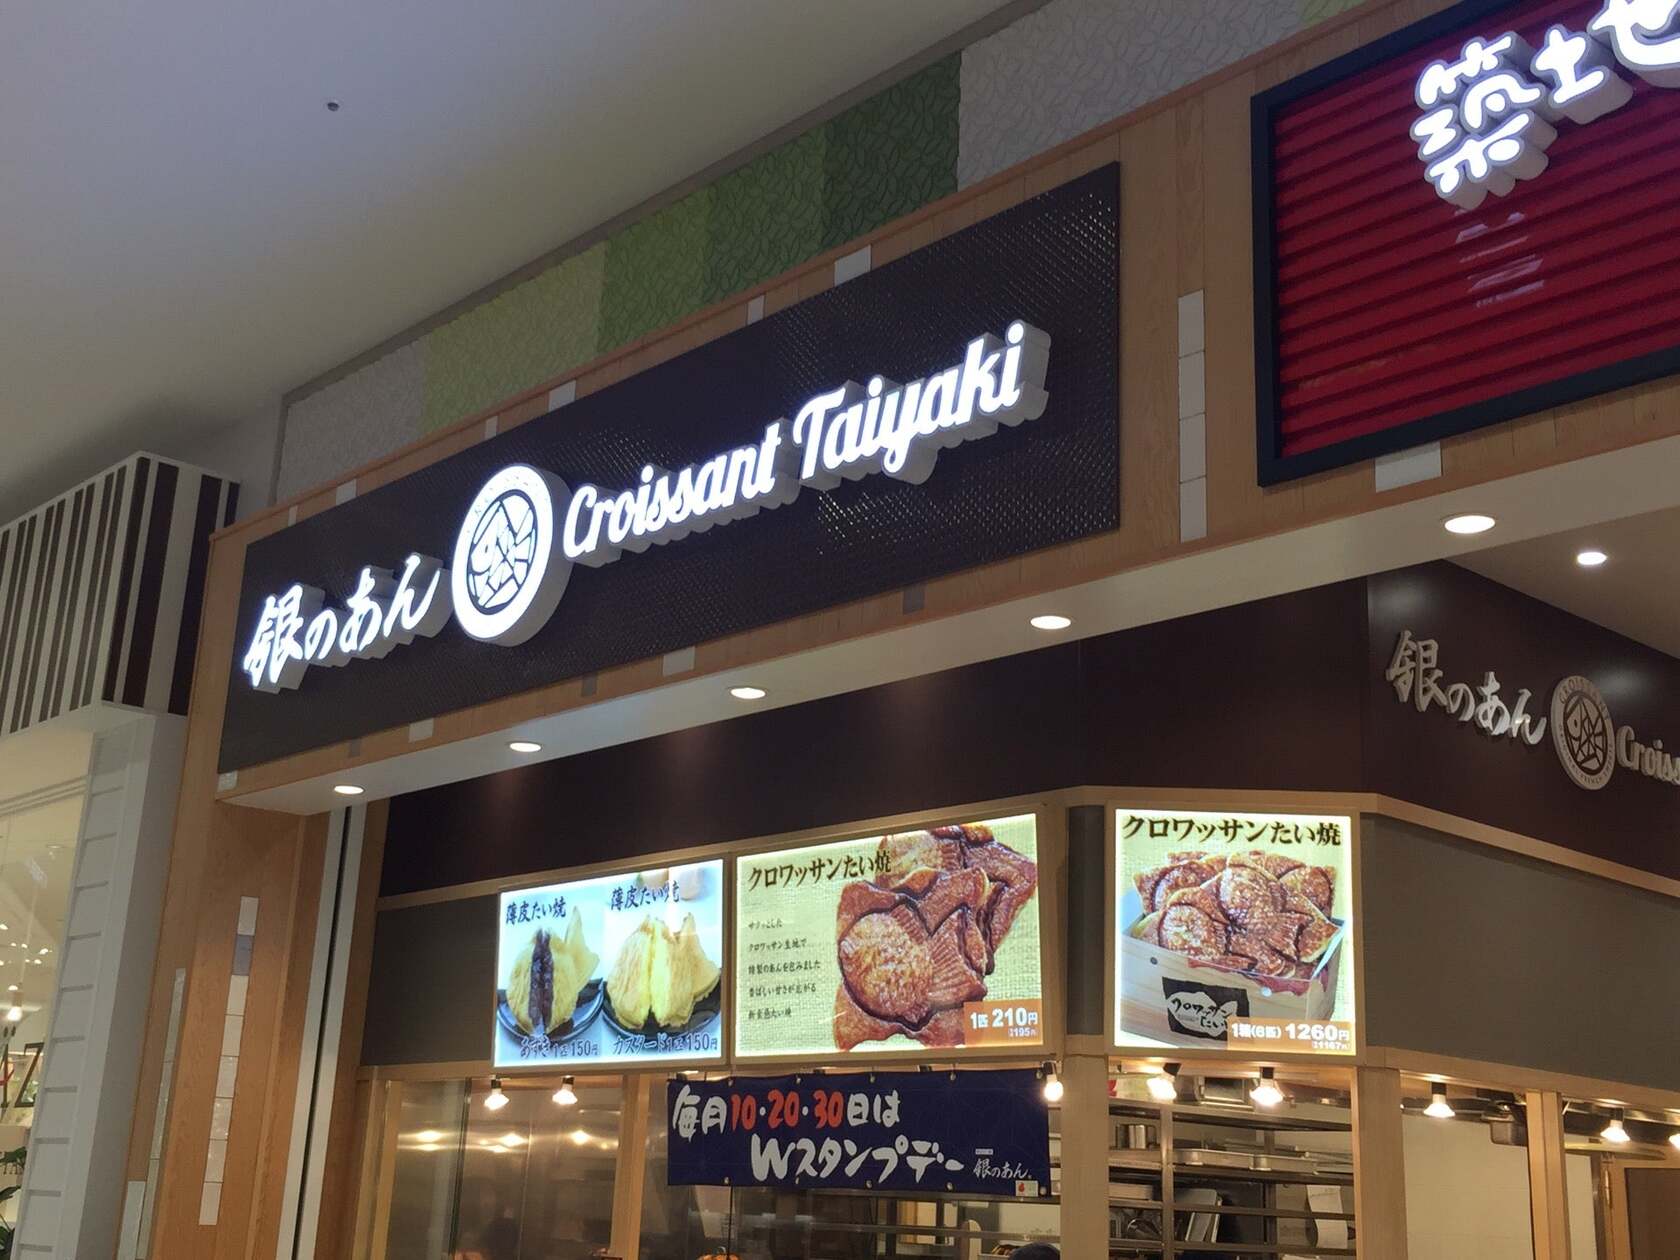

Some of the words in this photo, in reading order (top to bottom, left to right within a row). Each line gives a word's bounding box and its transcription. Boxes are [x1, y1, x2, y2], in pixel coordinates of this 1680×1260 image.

[563, 425, 781, 558] Croissant
[793, 321, 1023, 479] Taiyaki
[243, 552, 440, 687] 銀のあん
[1386, 630, 1547, 746] 銀のあん
[1122, 814, 1341, 847] クロワッサンたい焼
[748, 850, 892, 892] クロワッサンたい焼
[505, 895, 567, 925] 薄皮たい焼
[992, 1007, 1038, 1027] 210円
[1285, 1022, 1350, 1041] 1260円
[751, 1133, 964, 1184] Wスタンプデー
[973, 1158, 1028, 1178] 銀のあん
